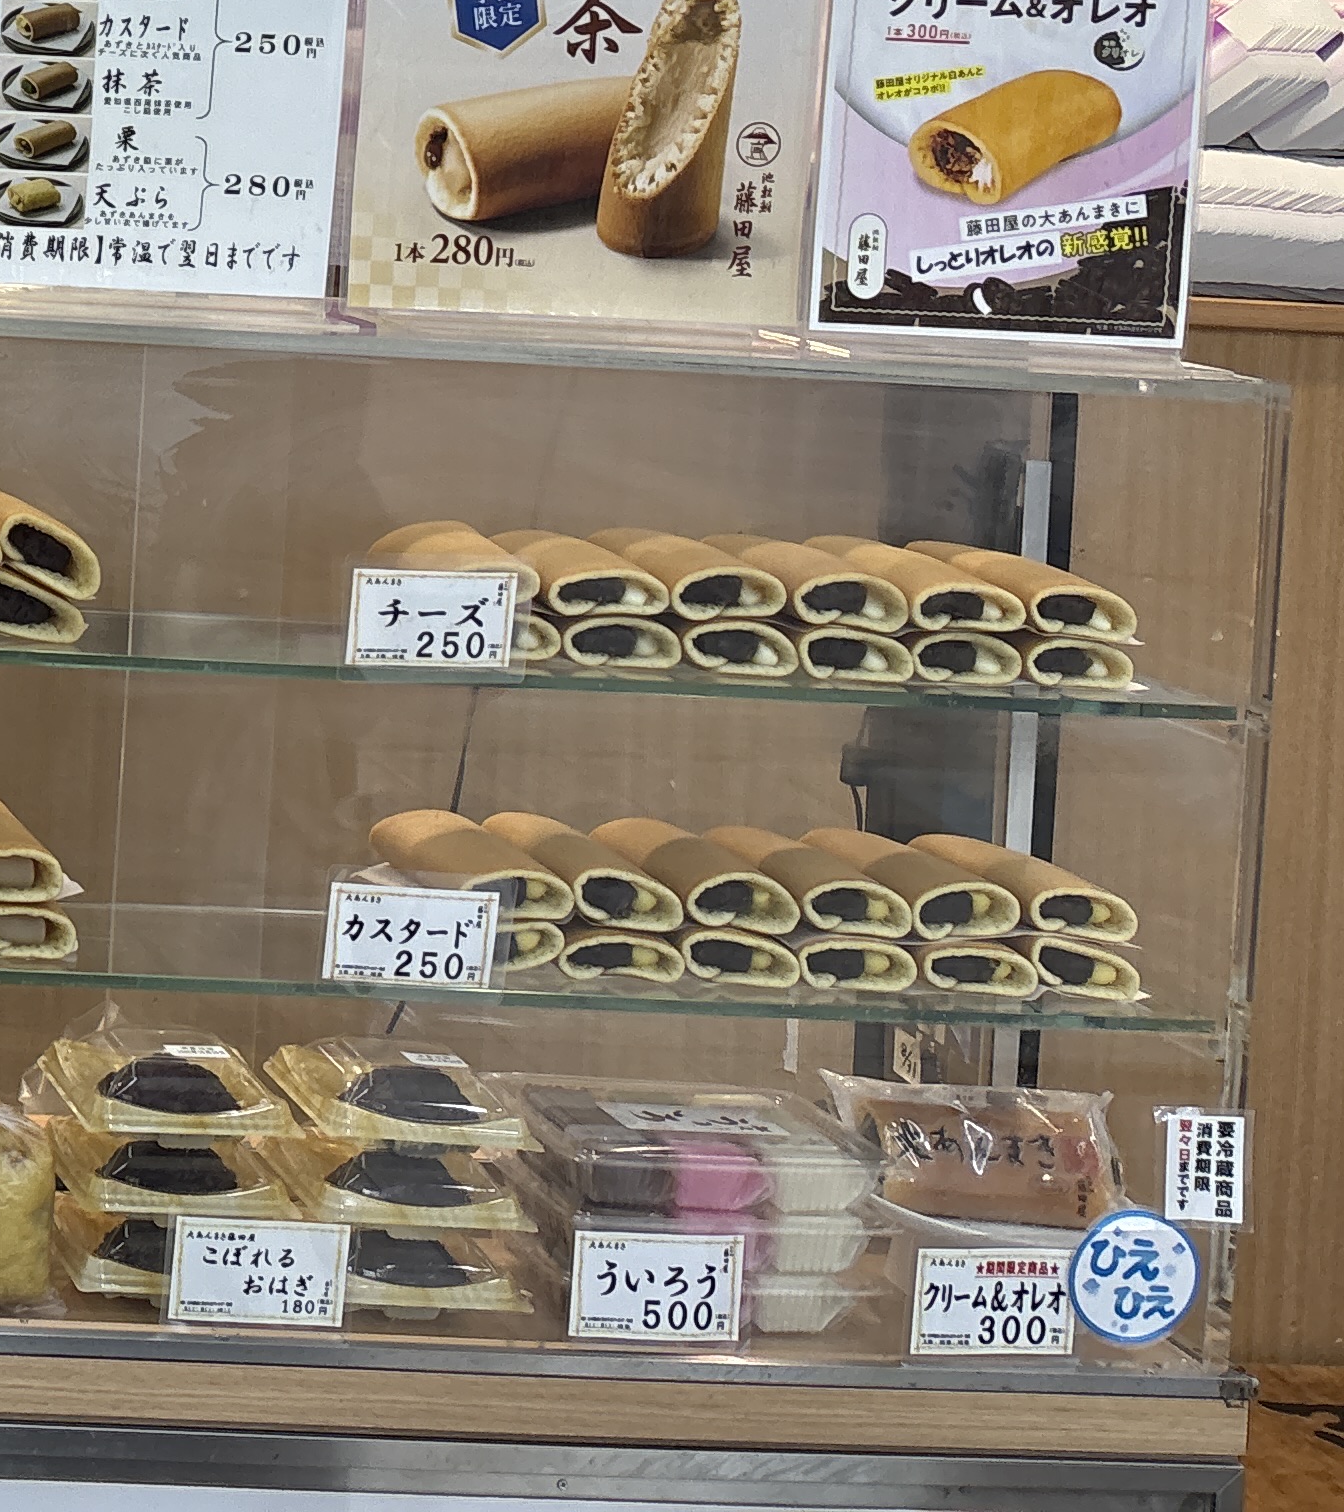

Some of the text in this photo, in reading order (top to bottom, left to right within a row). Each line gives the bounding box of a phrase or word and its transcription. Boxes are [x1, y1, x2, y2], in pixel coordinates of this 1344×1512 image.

[98, 13, 189, 41] カスタード
[234, 31, 301, 56] 250
[102, 68, 163, 97] 抹茶
[114, 125, 140, 153] 栗
[93, 183, 168, 209] 天ぷら
[223, 173, 291, 198] 280
[726, 180, 759, 278] 藤田屋
[965, 200, 1140, 238] 藤田屋の大あんまきに
[377, 597, 490, 628] チーズ
[415, 631, 485, 659] 250
[342, 913, 473, 950] カスタード
[394, 950, 464, 980] 250
[1194, 1121, 1213, 1193] 消費期限
[202, 1245, 295, 1269] こぼれる
[1089, 1238, 1160, 1282] ひえ
[242, 1274, 314, 1297] おはぎ
[596, 1259, 717, 1300] ういろう
[281, 1299, 315, 1315] 180
[923, 1280, 1067, 1316] クリーム&オレオ
[1113, 1285, 1176, 1320] ひえ
[641, 1299, 713, 1331] 500
[977, 1315, 1046, 1346] 300
